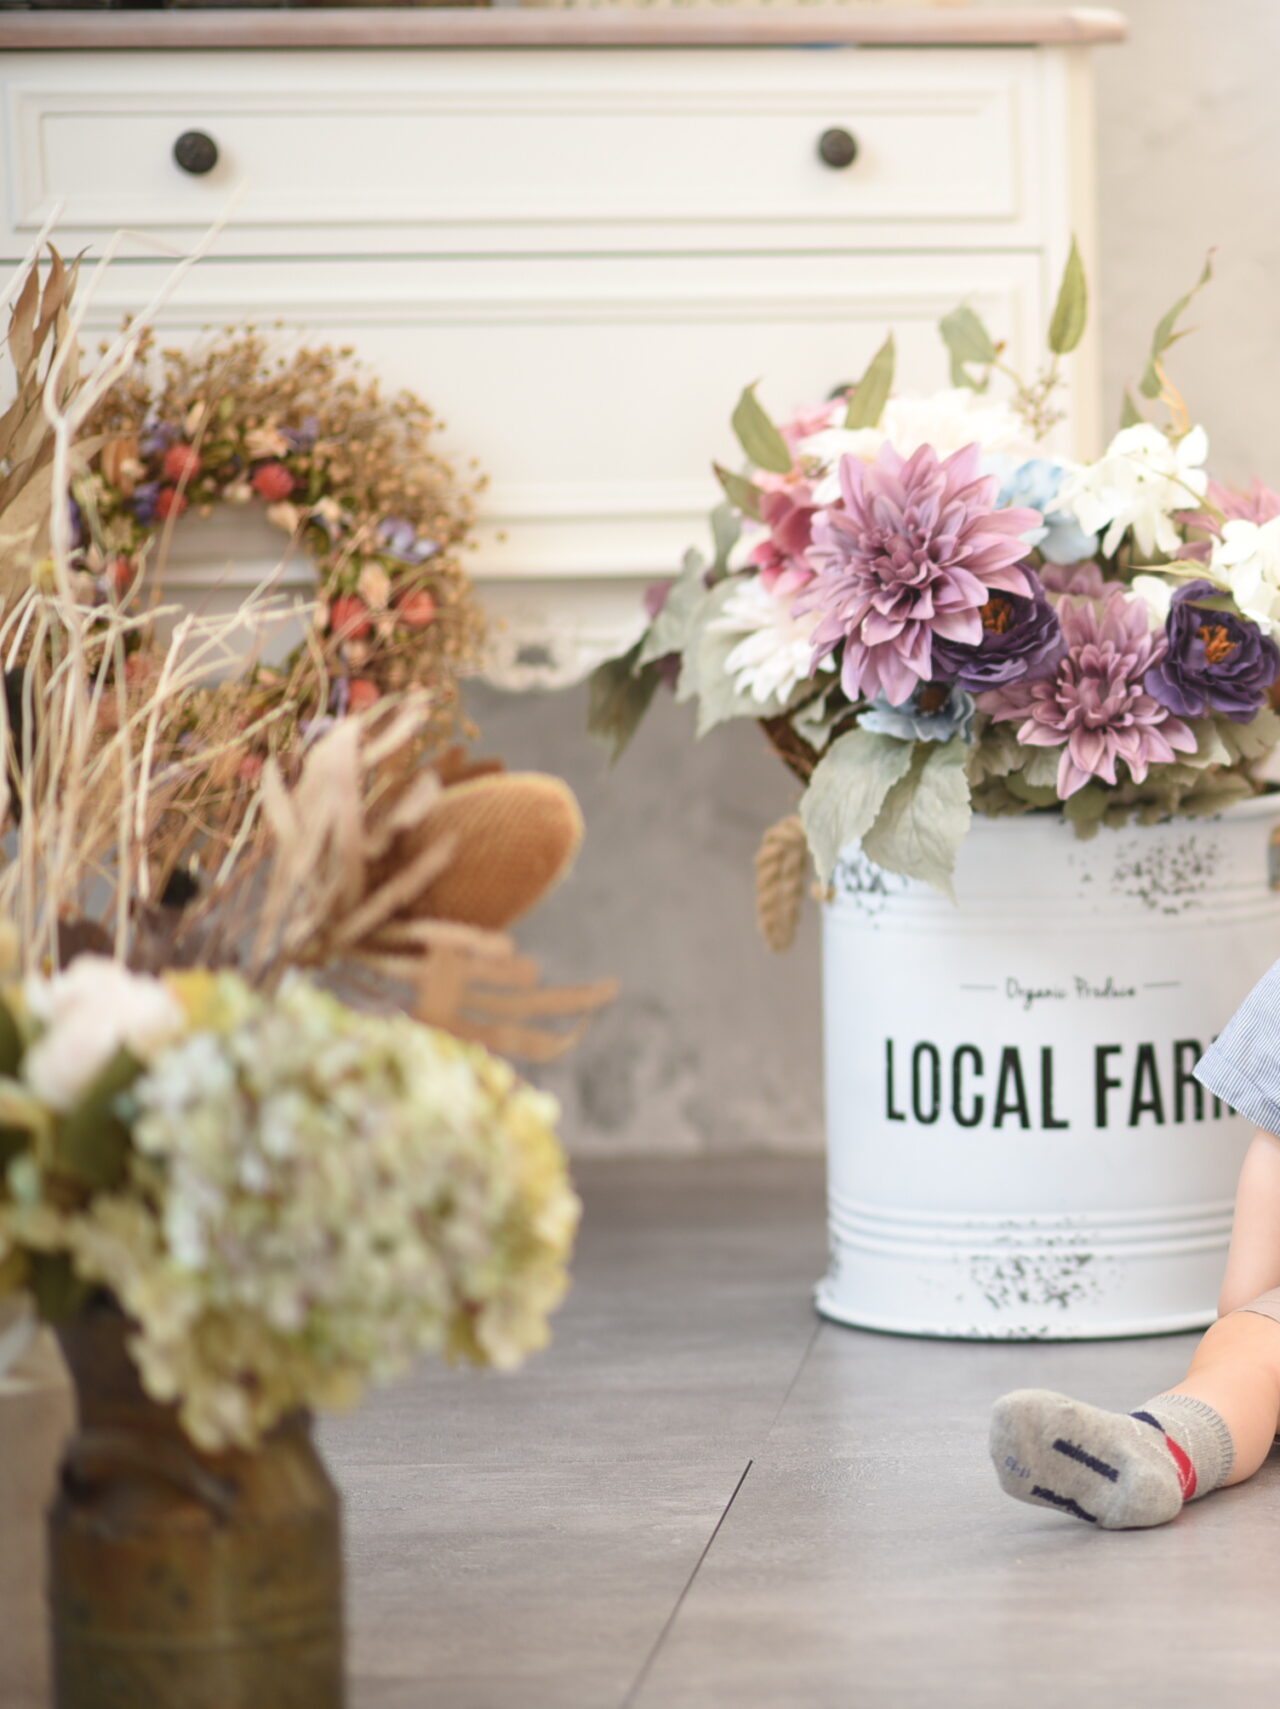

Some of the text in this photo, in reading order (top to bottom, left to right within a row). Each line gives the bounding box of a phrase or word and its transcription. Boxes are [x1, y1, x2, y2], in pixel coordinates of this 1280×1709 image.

[1006, 976, 1067, 1011] Organic
[886, 1034, 1238, 1130] LOCAL FAR
